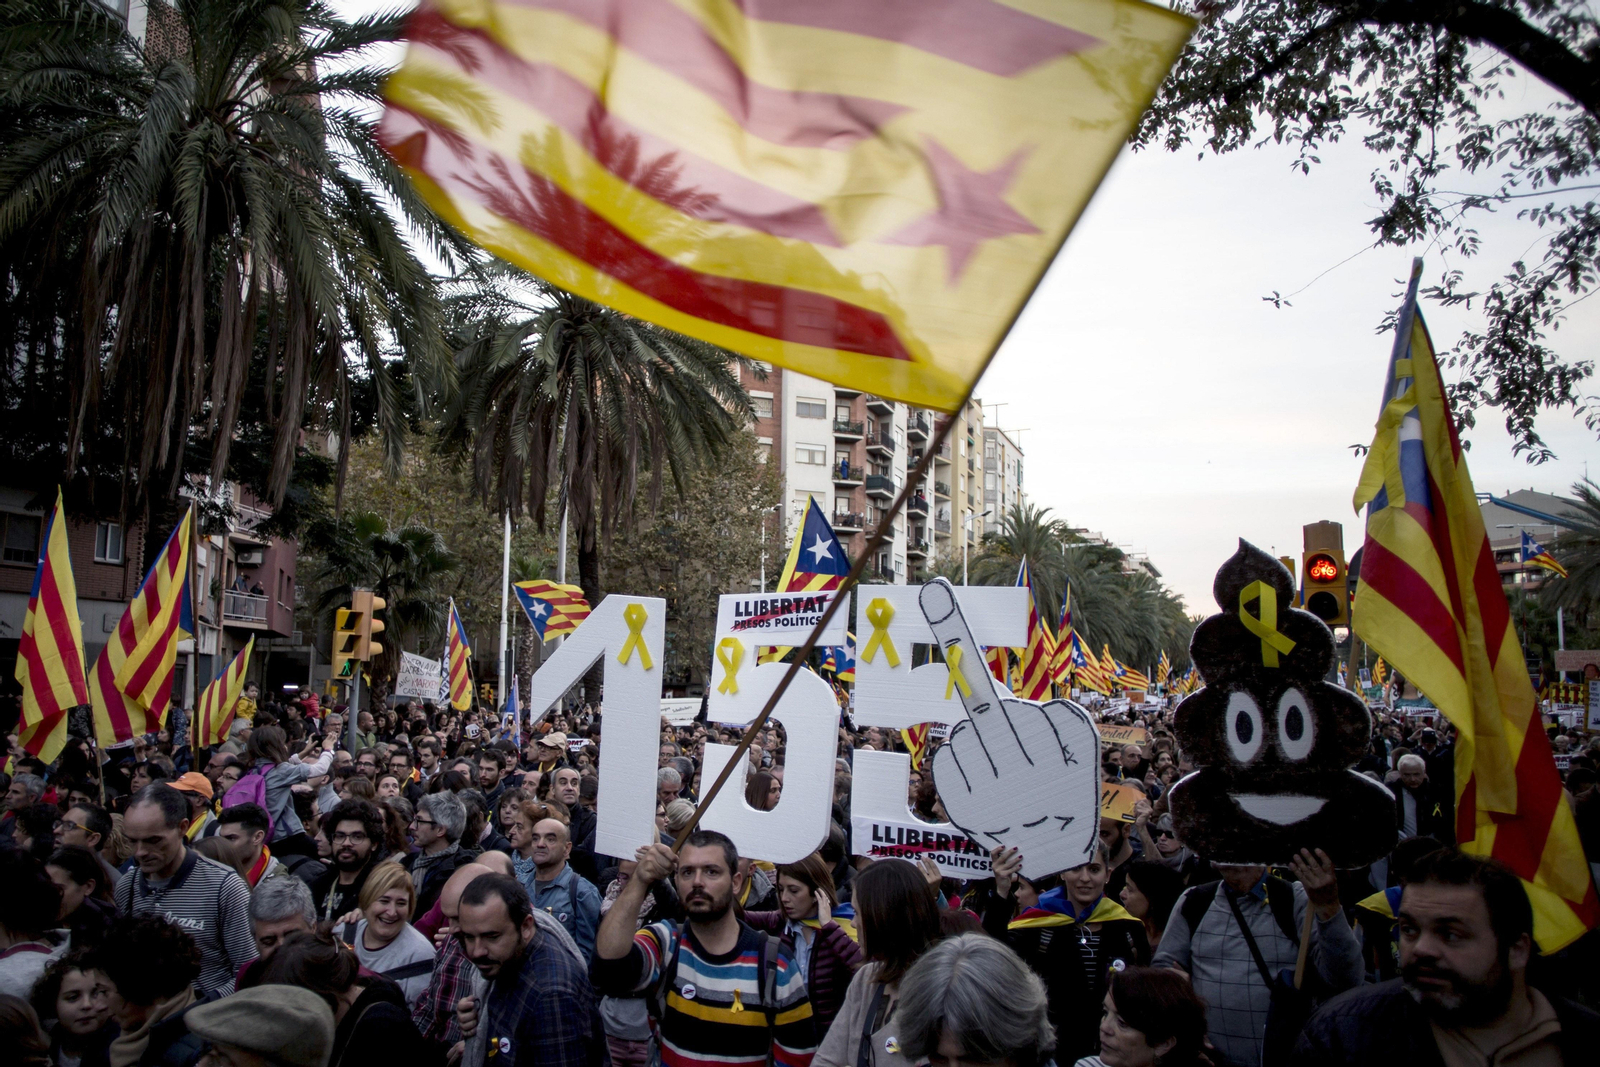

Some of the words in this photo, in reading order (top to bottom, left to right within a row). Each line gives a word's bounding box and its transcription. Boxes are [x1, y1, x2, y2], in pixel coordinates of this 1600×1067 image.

[735, 596, 827, 617] LLIBERTAT
[734, 618, 771, 629] PRESOS
[871, 845, 922, 860] PRESOS
[928, 853, 993, 871] POLÍTICS!
